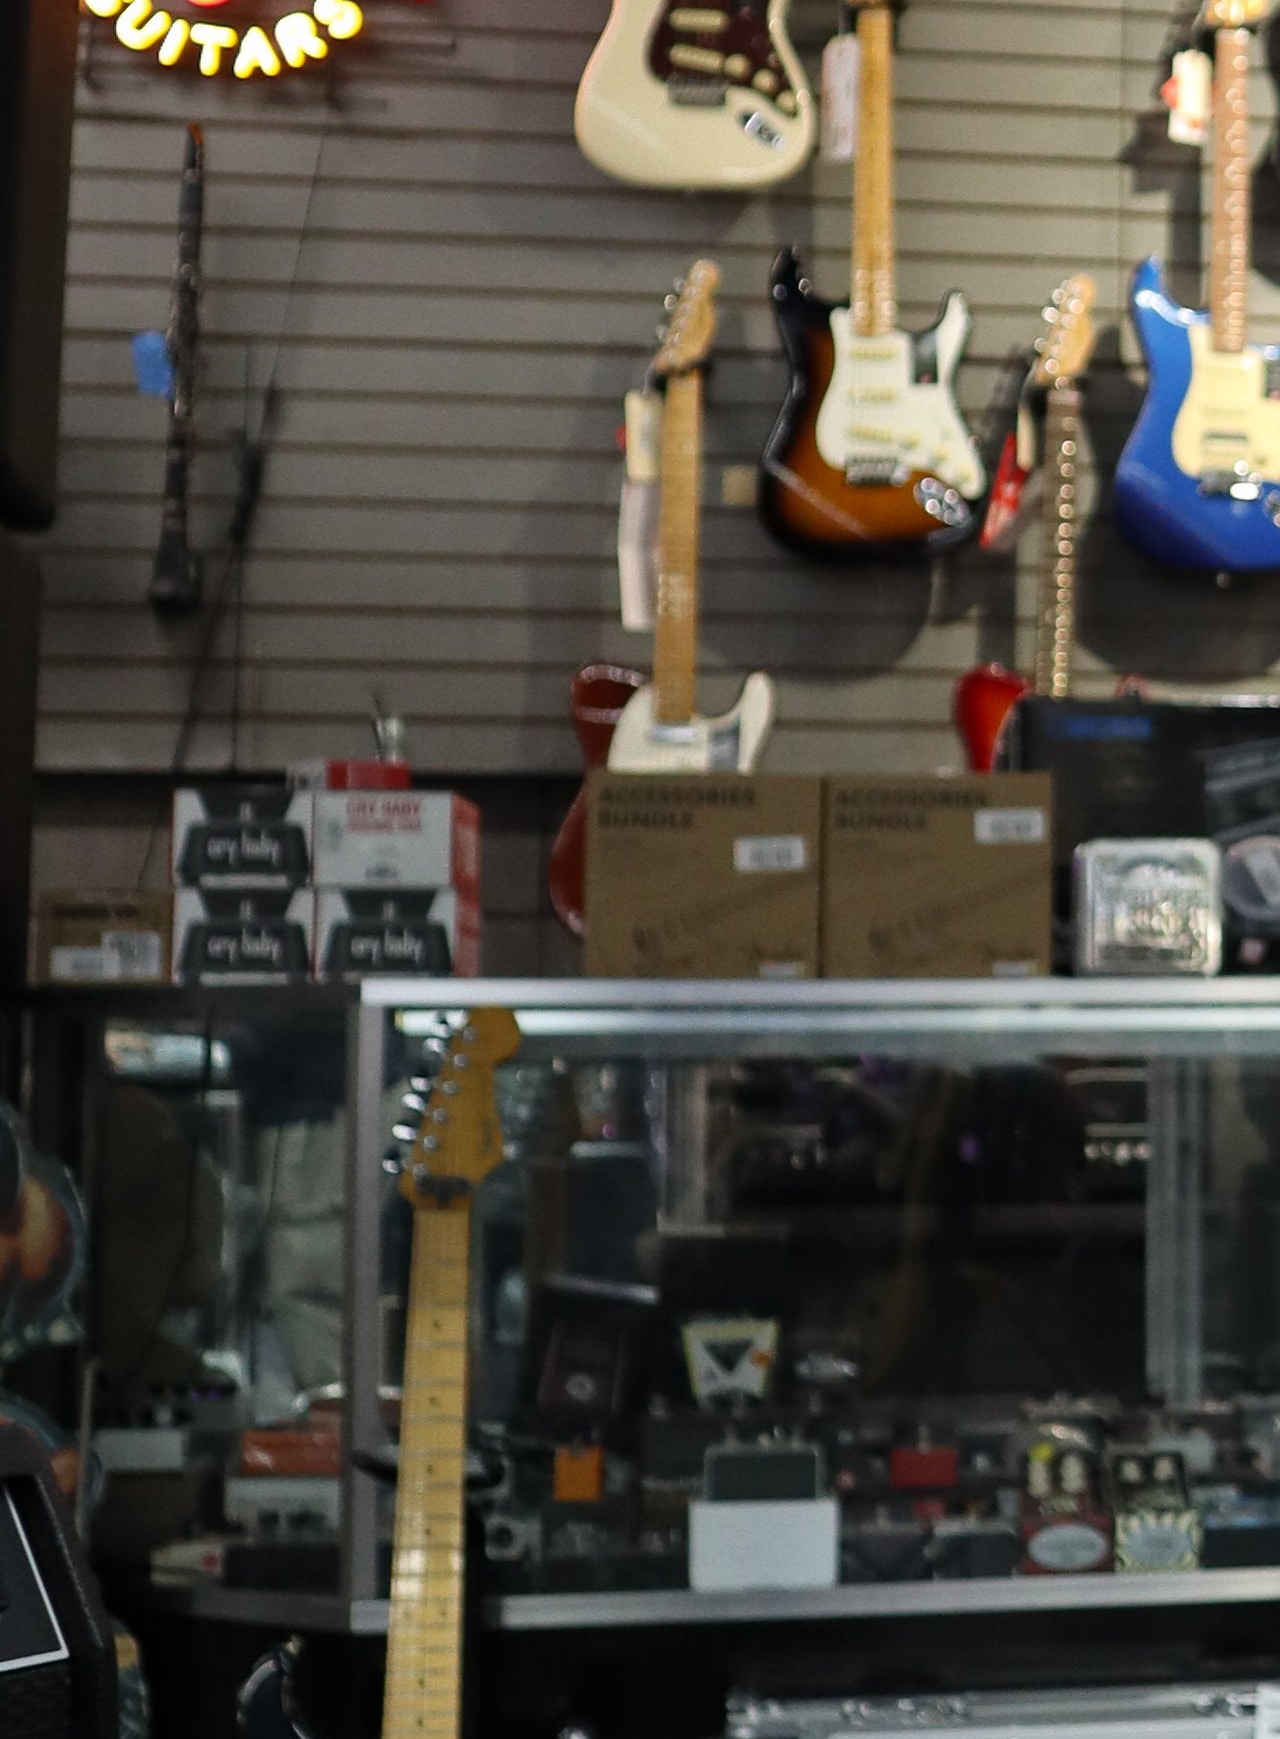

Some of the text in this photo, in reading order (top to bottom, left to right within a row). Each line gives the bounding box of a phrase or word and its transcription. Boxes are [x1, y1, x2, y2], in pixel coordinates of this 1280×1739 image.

[599, 785, 756, 807] ACCESSORIES
[835, 787, 990, 810] ACCESSORIES
[598, 807, 695, 830] BUNDLE
[835, 809, 928, 832] BUNDLE
